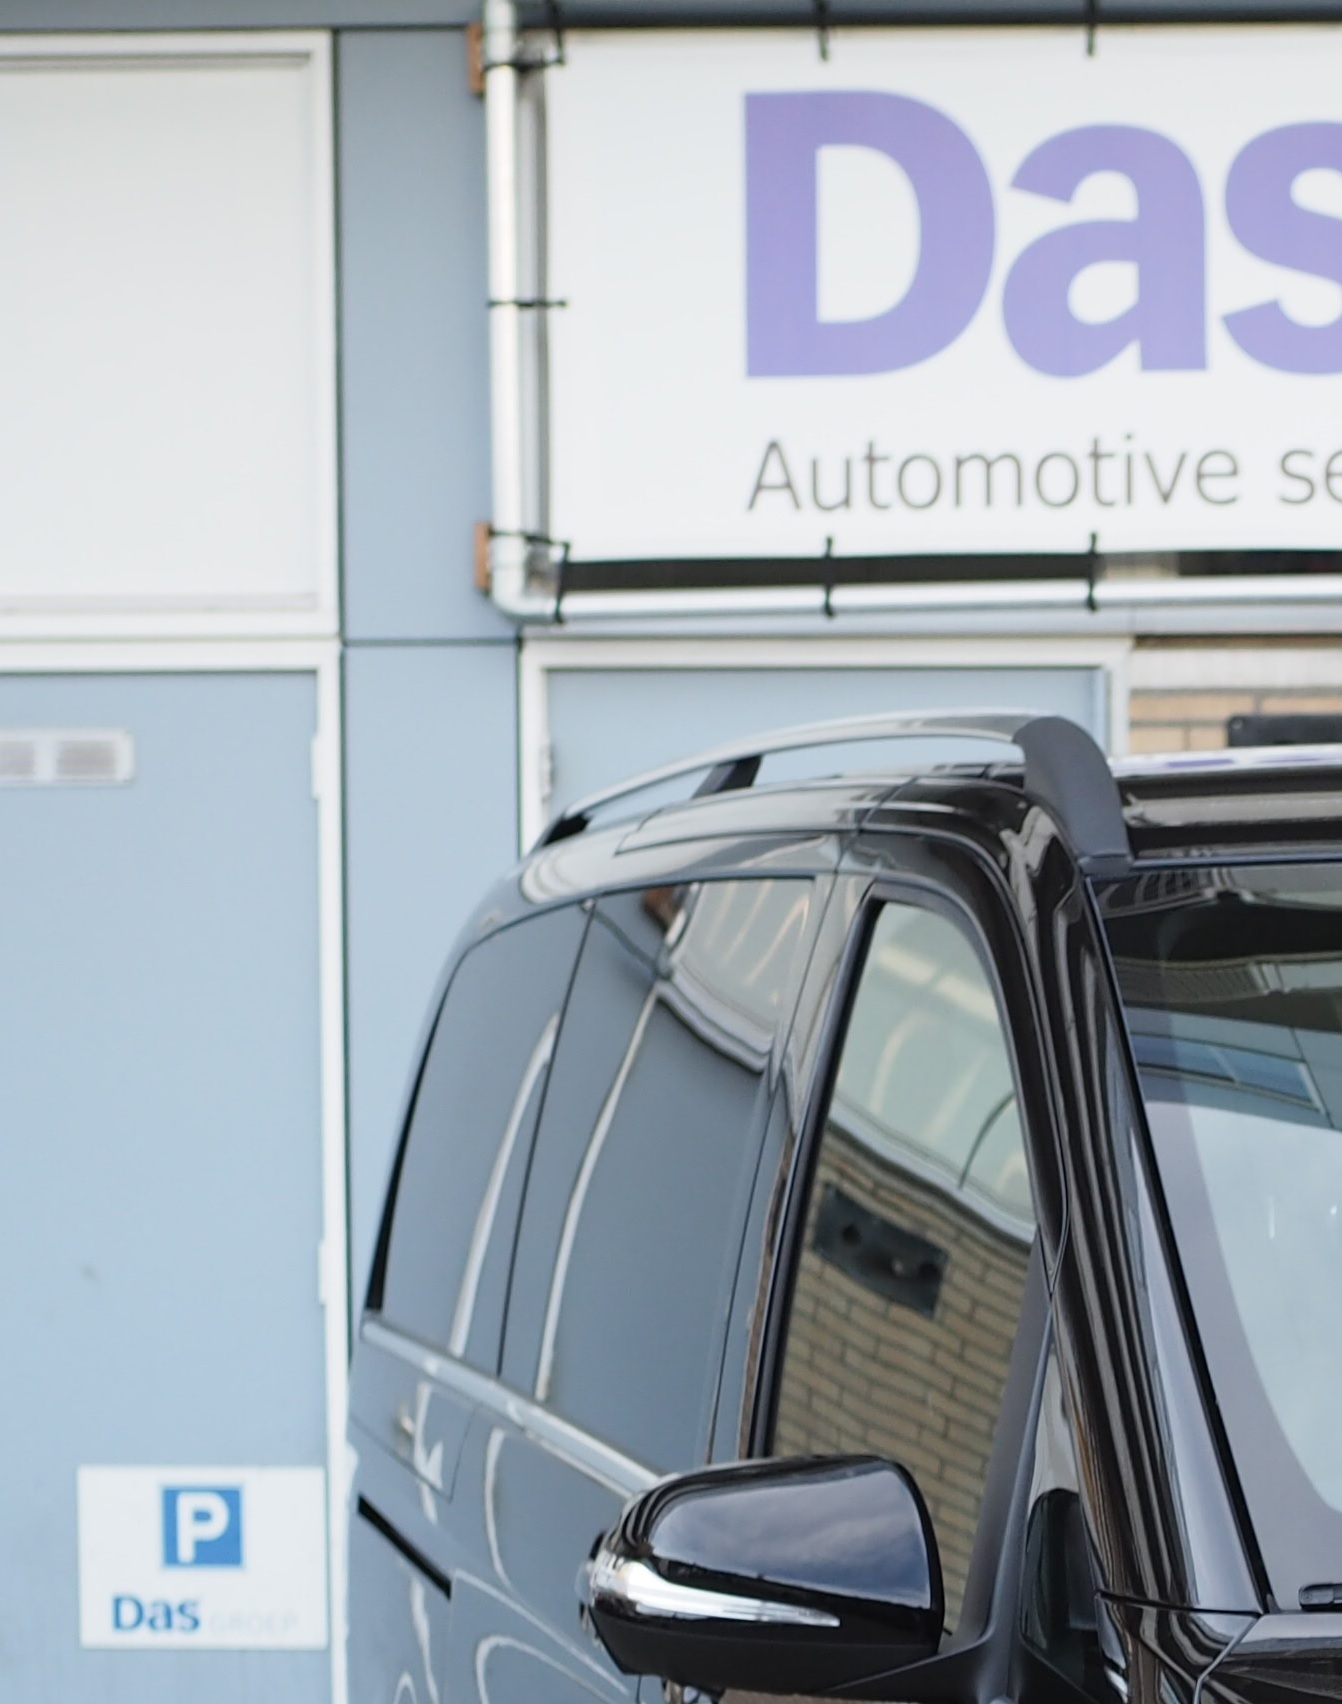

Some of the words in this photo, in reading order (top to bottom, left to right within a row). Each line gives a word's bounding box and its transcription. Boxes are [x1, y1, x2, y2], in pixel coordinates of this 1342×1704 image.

[746, 432, 1240, 513] Automotive
[176, 1491, 229, 1564] P
[111, 1594, 201, 1632] Das
